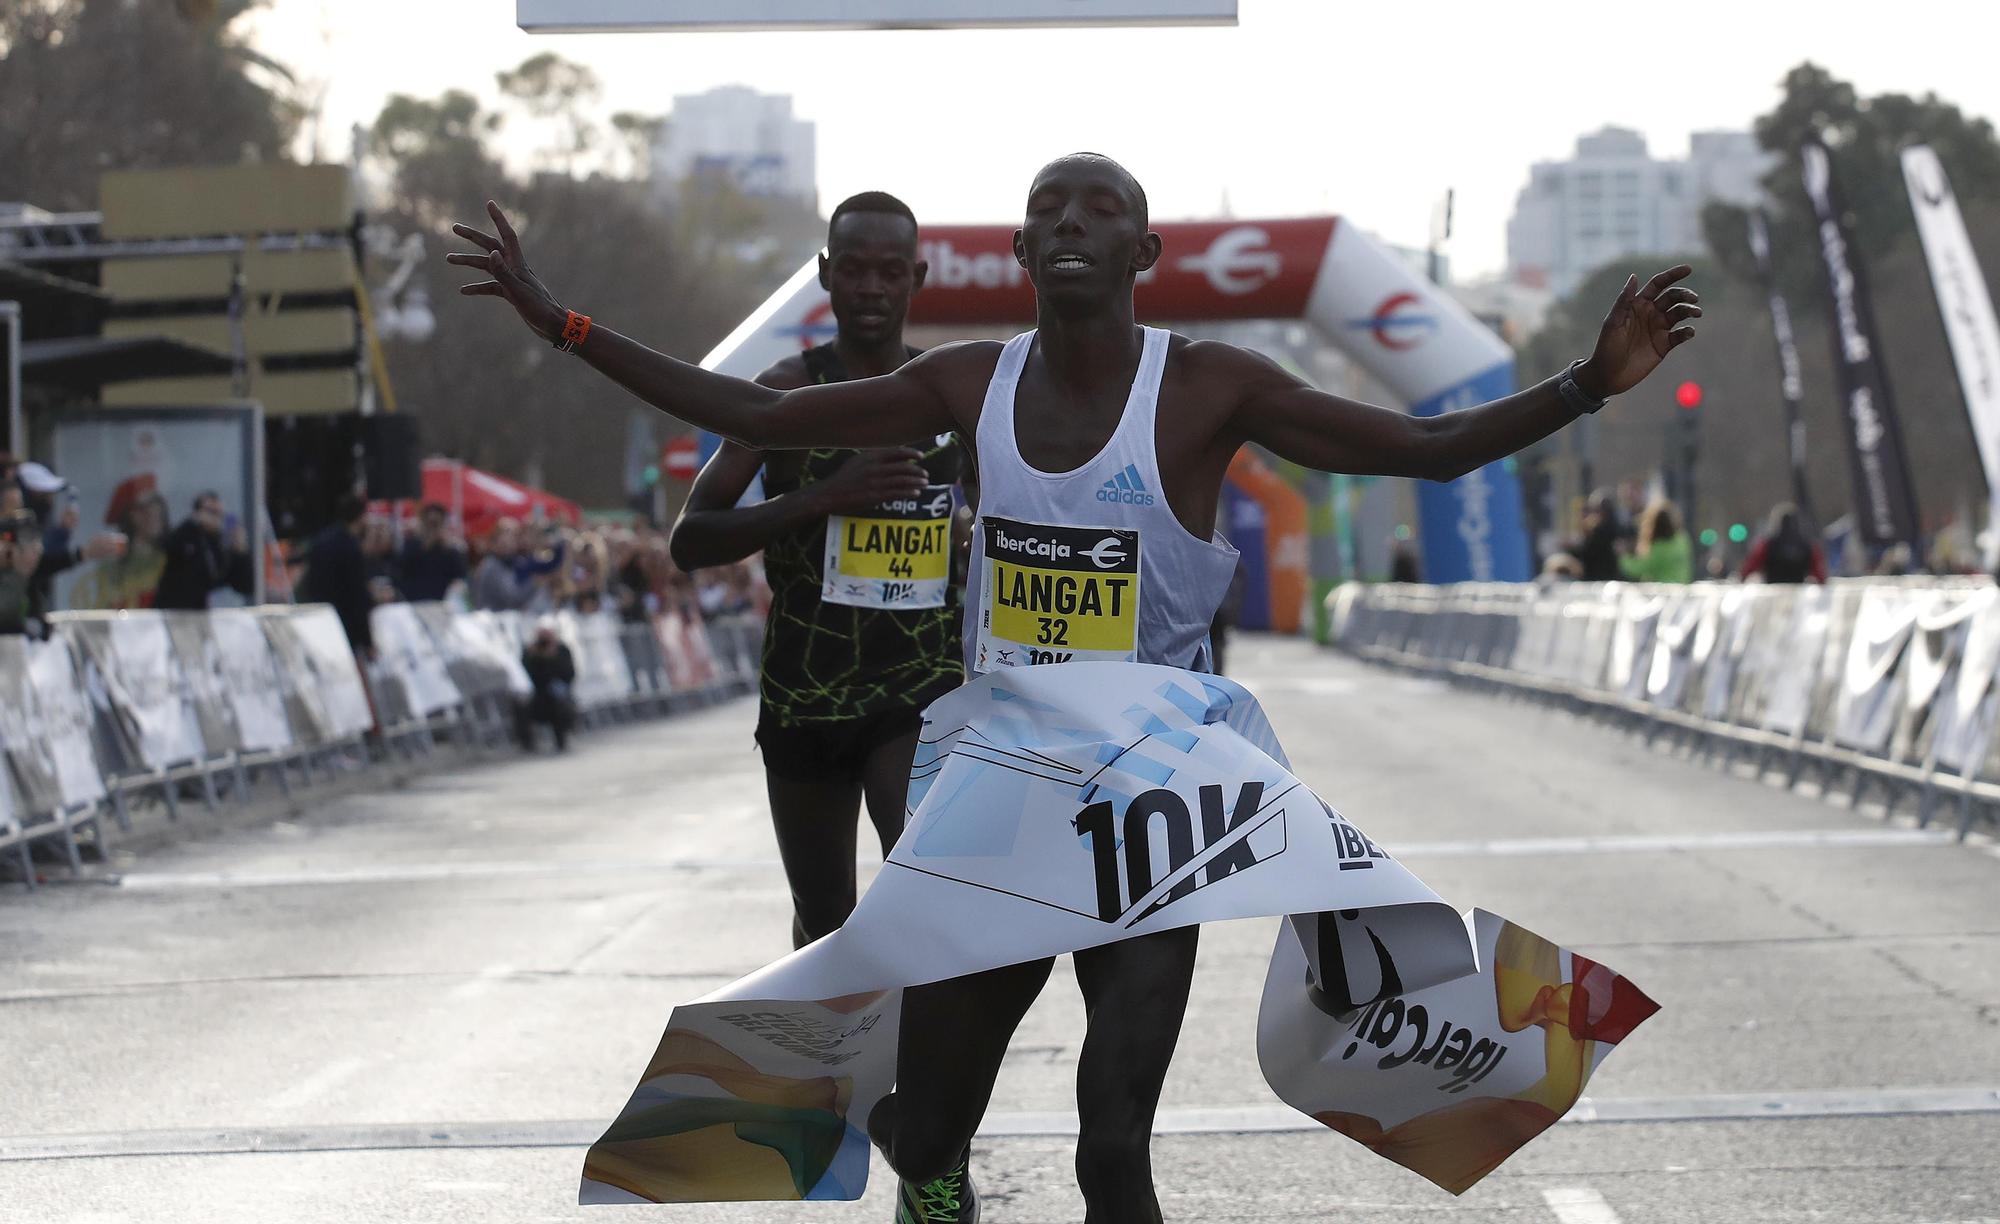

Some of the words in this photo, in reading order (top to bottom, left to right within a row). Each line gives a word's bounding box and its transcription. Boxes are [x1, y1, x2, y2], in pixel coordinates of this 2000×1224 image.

[1096, 488, 1154, 506] adidas
[847, 522, 945, 554] LANGAT
[996, 529, 1071, 561] iberCaja
[888, 557, 913, 578] 44
[998, 566, 1128, 617] LANGAT
[1037, 617, 1068, 646] 32
[1075, 781, 1265, 923] 10K
[1342, 997, 1508, 1093] iberCaj
